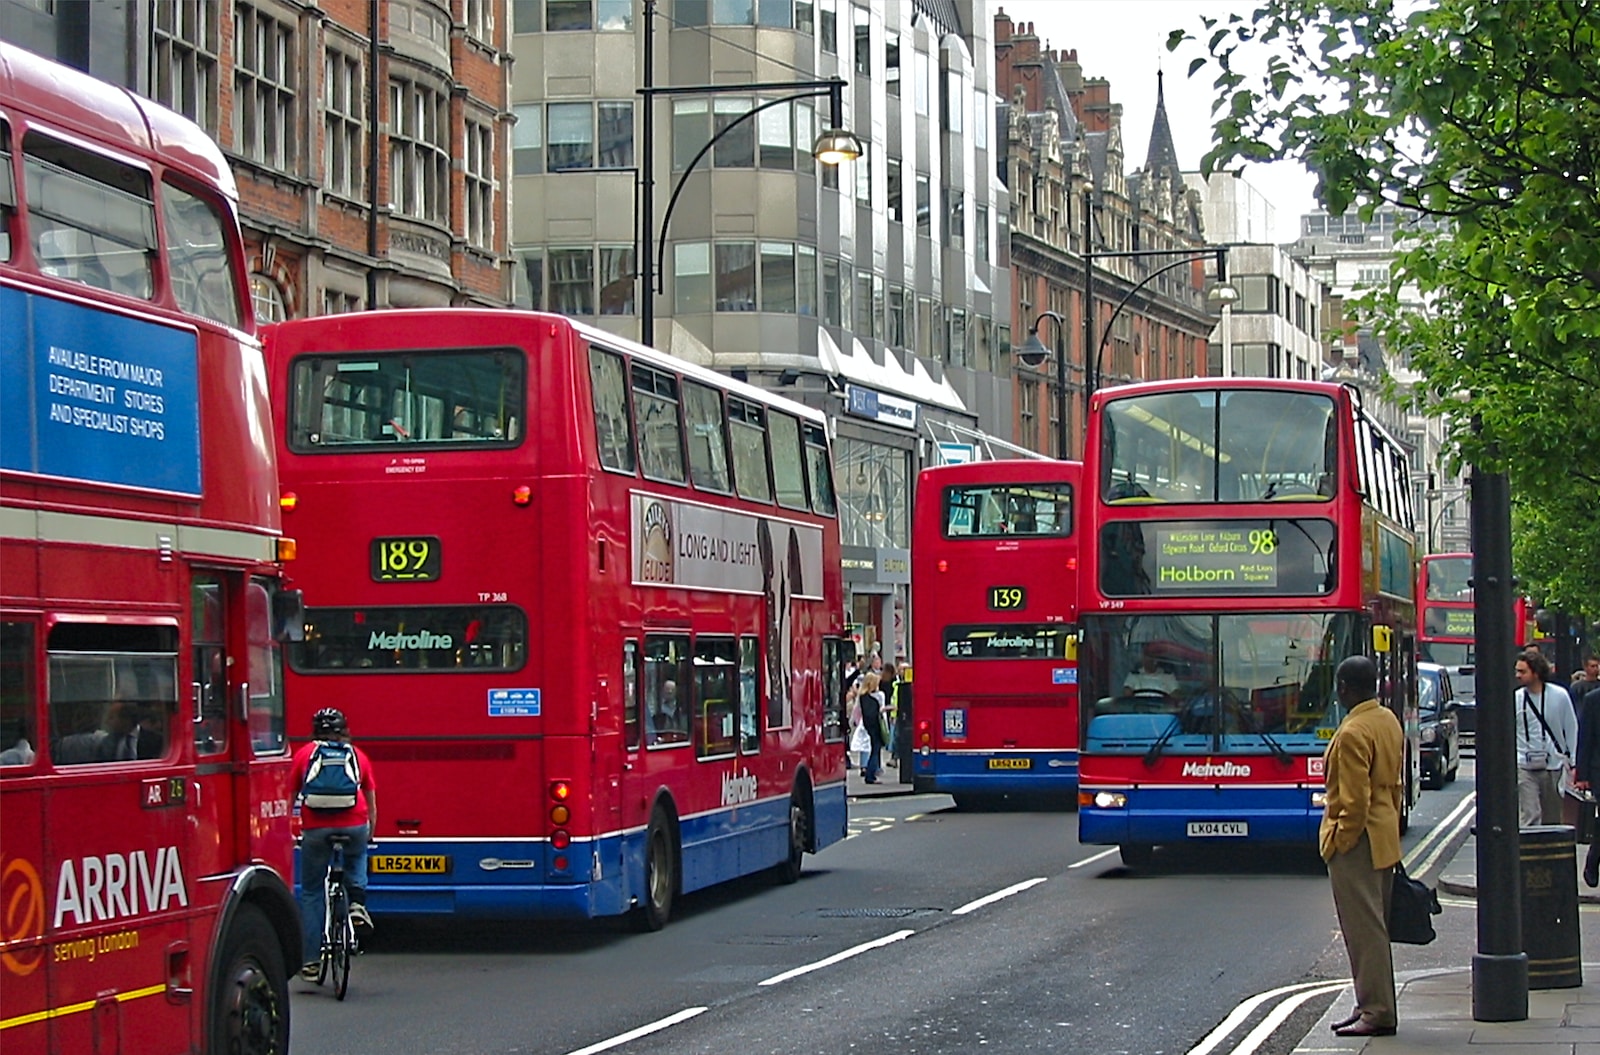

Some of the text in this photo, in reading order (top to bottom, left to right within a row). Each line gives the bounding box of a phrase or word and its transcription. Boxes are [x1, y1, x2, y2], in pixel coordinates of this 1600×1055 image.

[49, 346, 163, 388] AVAILABLE FROM MAJOR
[49, 374, 164, 414] DEPARTMENT STORES
[50, 403, 164, 440] AND SPECIALIST SHOPS
[680, 533, 757, 566] LONG AND LIGHT
[1189, 543, 1205, 553] Road
[1248, 530, 1274, 554] 98
[381, 541, 429, 571] 189
[645, 560, 670, 582] GLIDE
[1160, 565, 1235, 581] Holborn
[1244, 573, 1269, 581] Square
[478, 592, 490, 602] TP
[994, 589, 1022, 607] 139
[1099, 600, 1110, 609] VP
[368, 629, 453, 650] Metroline
[987, 635, 1034, 647] Metroline
[945, 719, 964, 730] BUS
[1182, 761, 1251, 777] Metroline
[147, 785, 162, 804] AR
[721, 767, 758, 806] Metroline
[1191, 824, 1242, 834] LX04 CVL
[377, 857, 441, 870] LR52 KWK
[54, 846, 188, 928] ARRIVA
[54, 931, 139, 962] serving London
